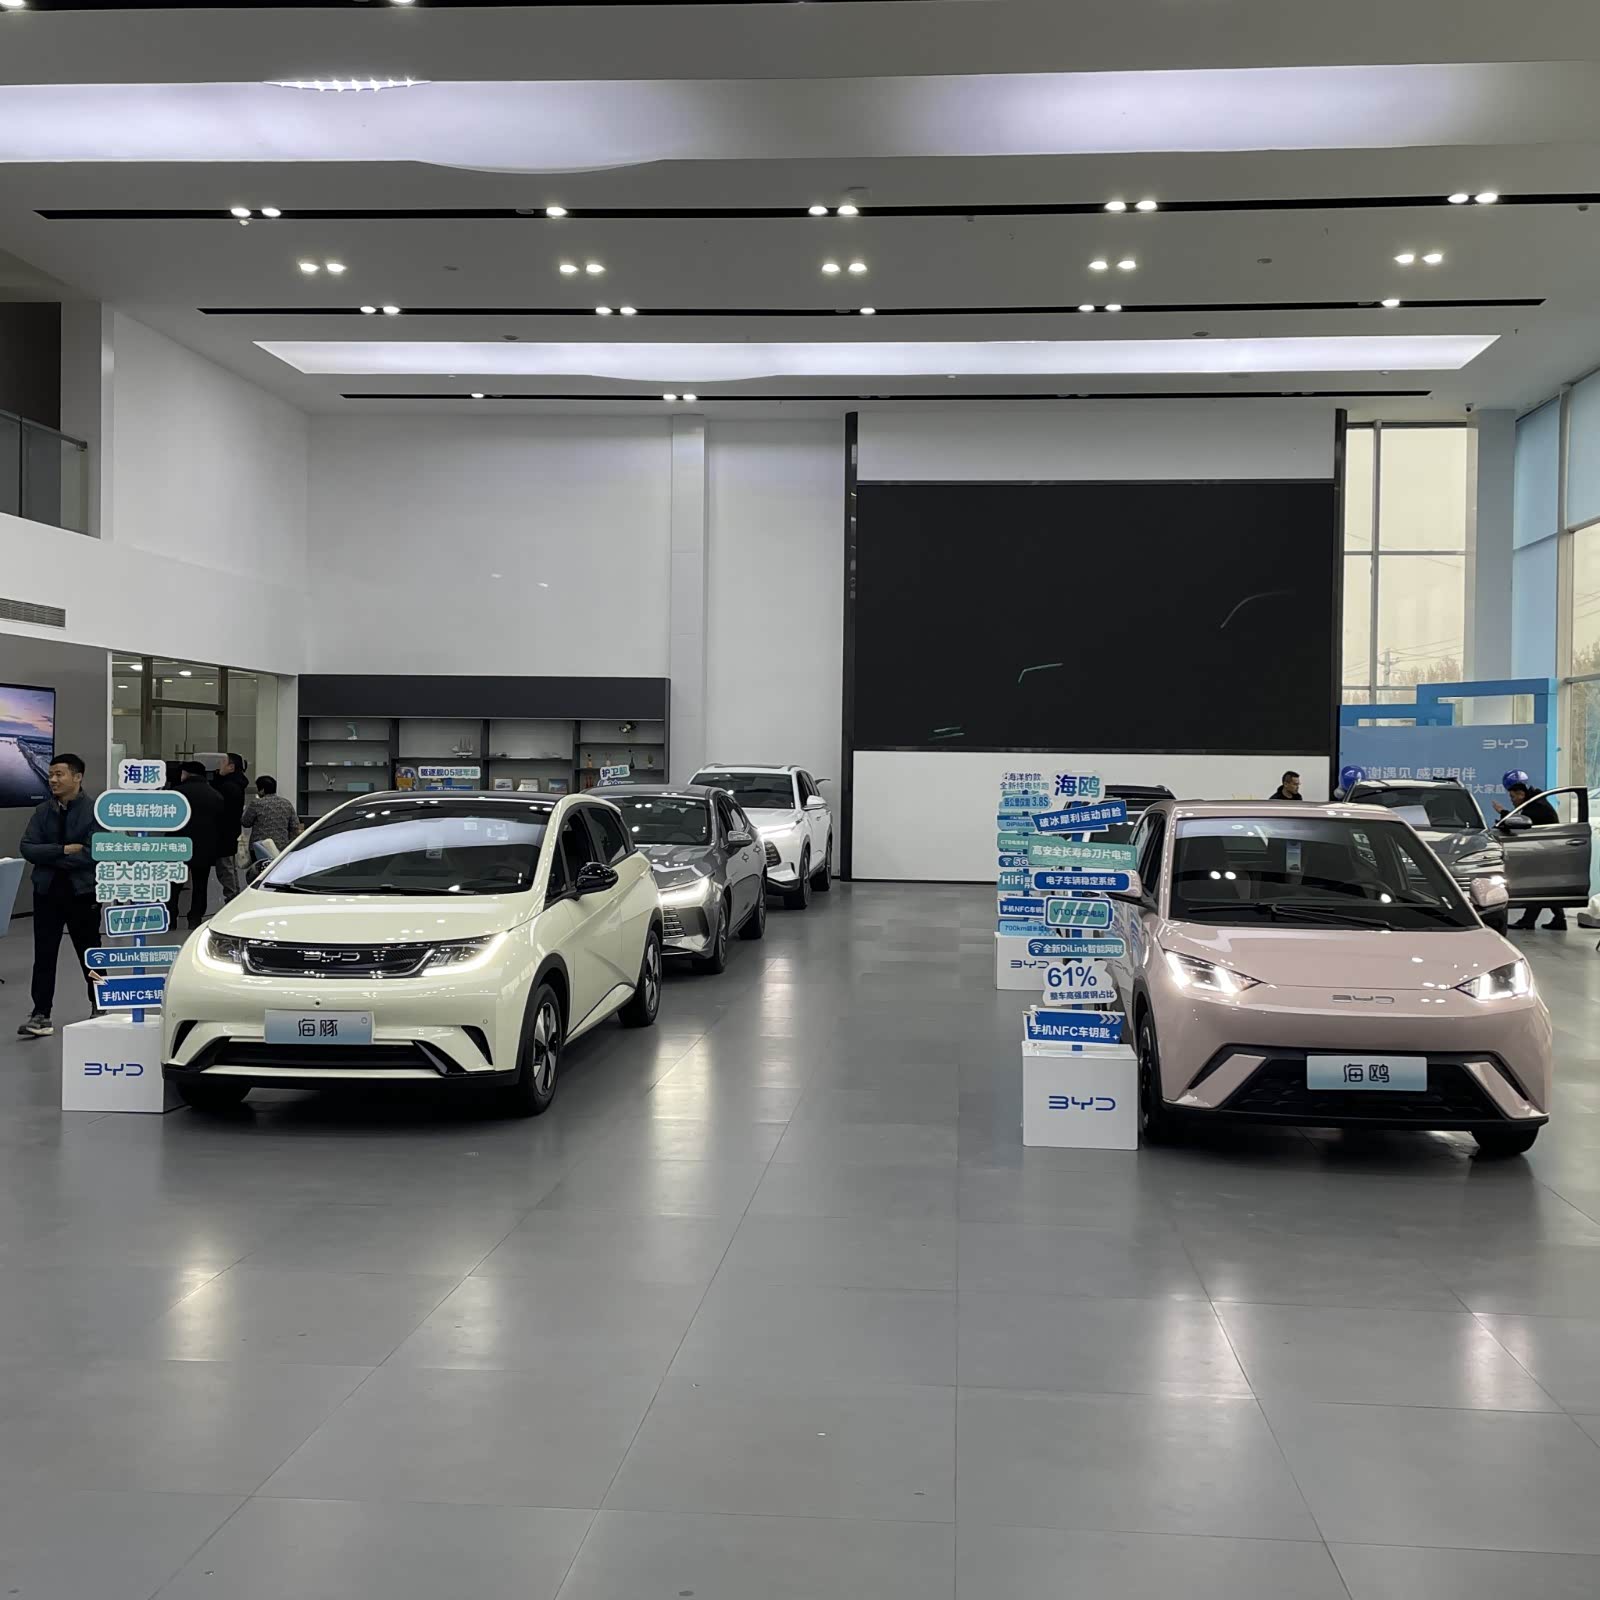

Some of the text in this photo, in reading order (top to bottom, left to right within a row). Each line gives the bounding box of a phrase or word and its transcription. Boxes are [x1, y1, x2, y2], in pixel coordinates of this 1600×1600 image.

[1483, 739, 1528, 749] BYD
[124, 765, 160, 784] 海豚
[1362, 767, 1411, 779] 谢遇见
[1054, 775, 1100, 797] 海鸥
[108, 803, 177, 818] 纯电新物种
[1040, 808, 1122, 828] 破冰犀利运动前脸
[95, 842, 187, 852] 高安全长寿命刀片电池
[1032, 845, 1132, 860] 高安全长寿命刀片电池
[98, 864, 186, 881] 超大的移动
[1002, 875, 1024, 885] HiFi
[1046, 877, 1117, 886] 电子车辆稳定系统
[98, 883, 168, 901] 舒享空间
[1043, 944, 1123, 954] 全新DiLink智能网联
[1011, 960, 1049, 969] BYD
[1047, 966, 1097, 987] 61%
[1050, 991, 1115, 1001] 整车高强度钢占比
[298, 1018, 339, 1037] 海豚
[1031, 1024, 1110, 1039] 手机NFC车钥匙
[84, 1062, 144, 1077] BYD
[1344, 1063, 1390, 1083] 海鸥
[1049, 1095, 1116, 1111] BYD
